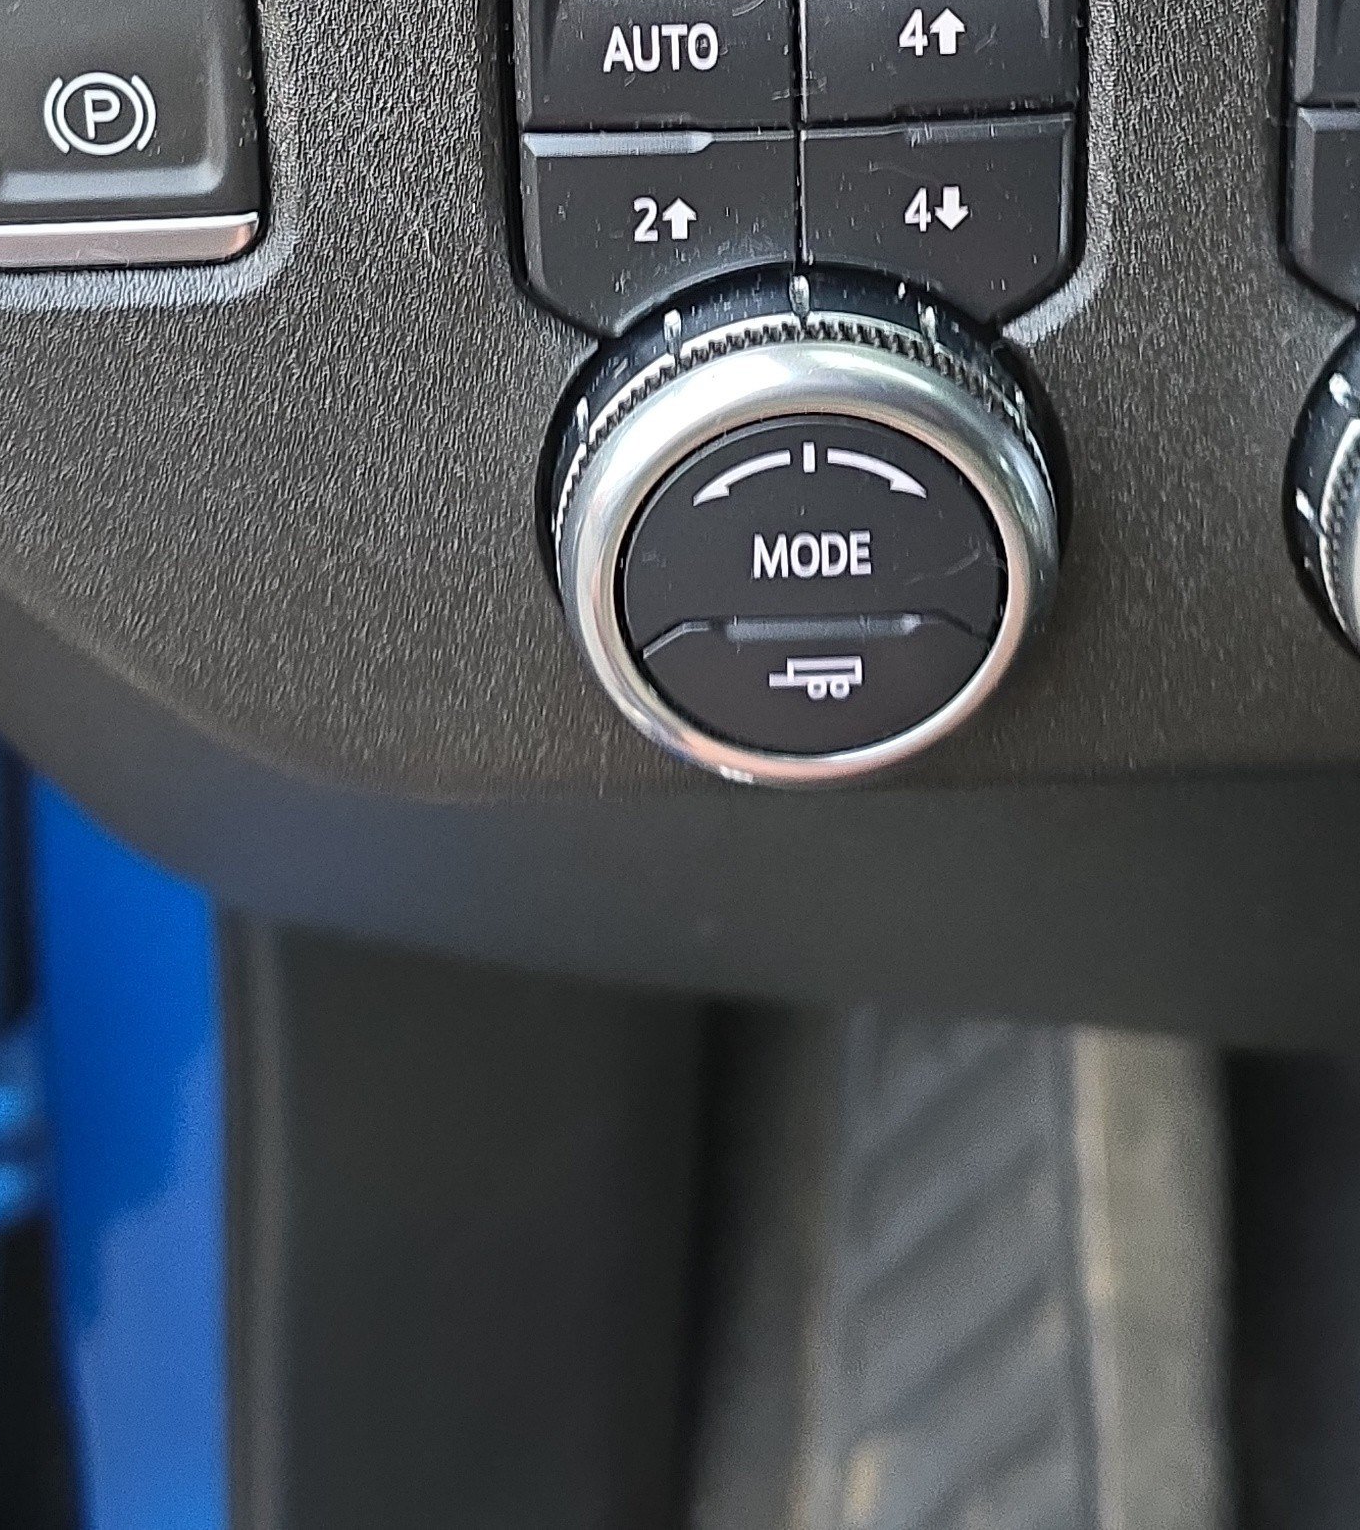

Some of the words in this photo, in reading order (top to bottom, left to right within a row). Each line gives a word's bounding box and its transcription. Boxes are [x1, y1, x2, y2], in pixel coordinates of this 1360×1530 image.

[602, 22, 719, 73] AUTO
[898, 8, 929, 56] 4
[83, 89, 120, 139] P
[633, 197, 659, 242] 2
[904, 187, 932, 232] 4
[753, 530, 872, 579] MODE
